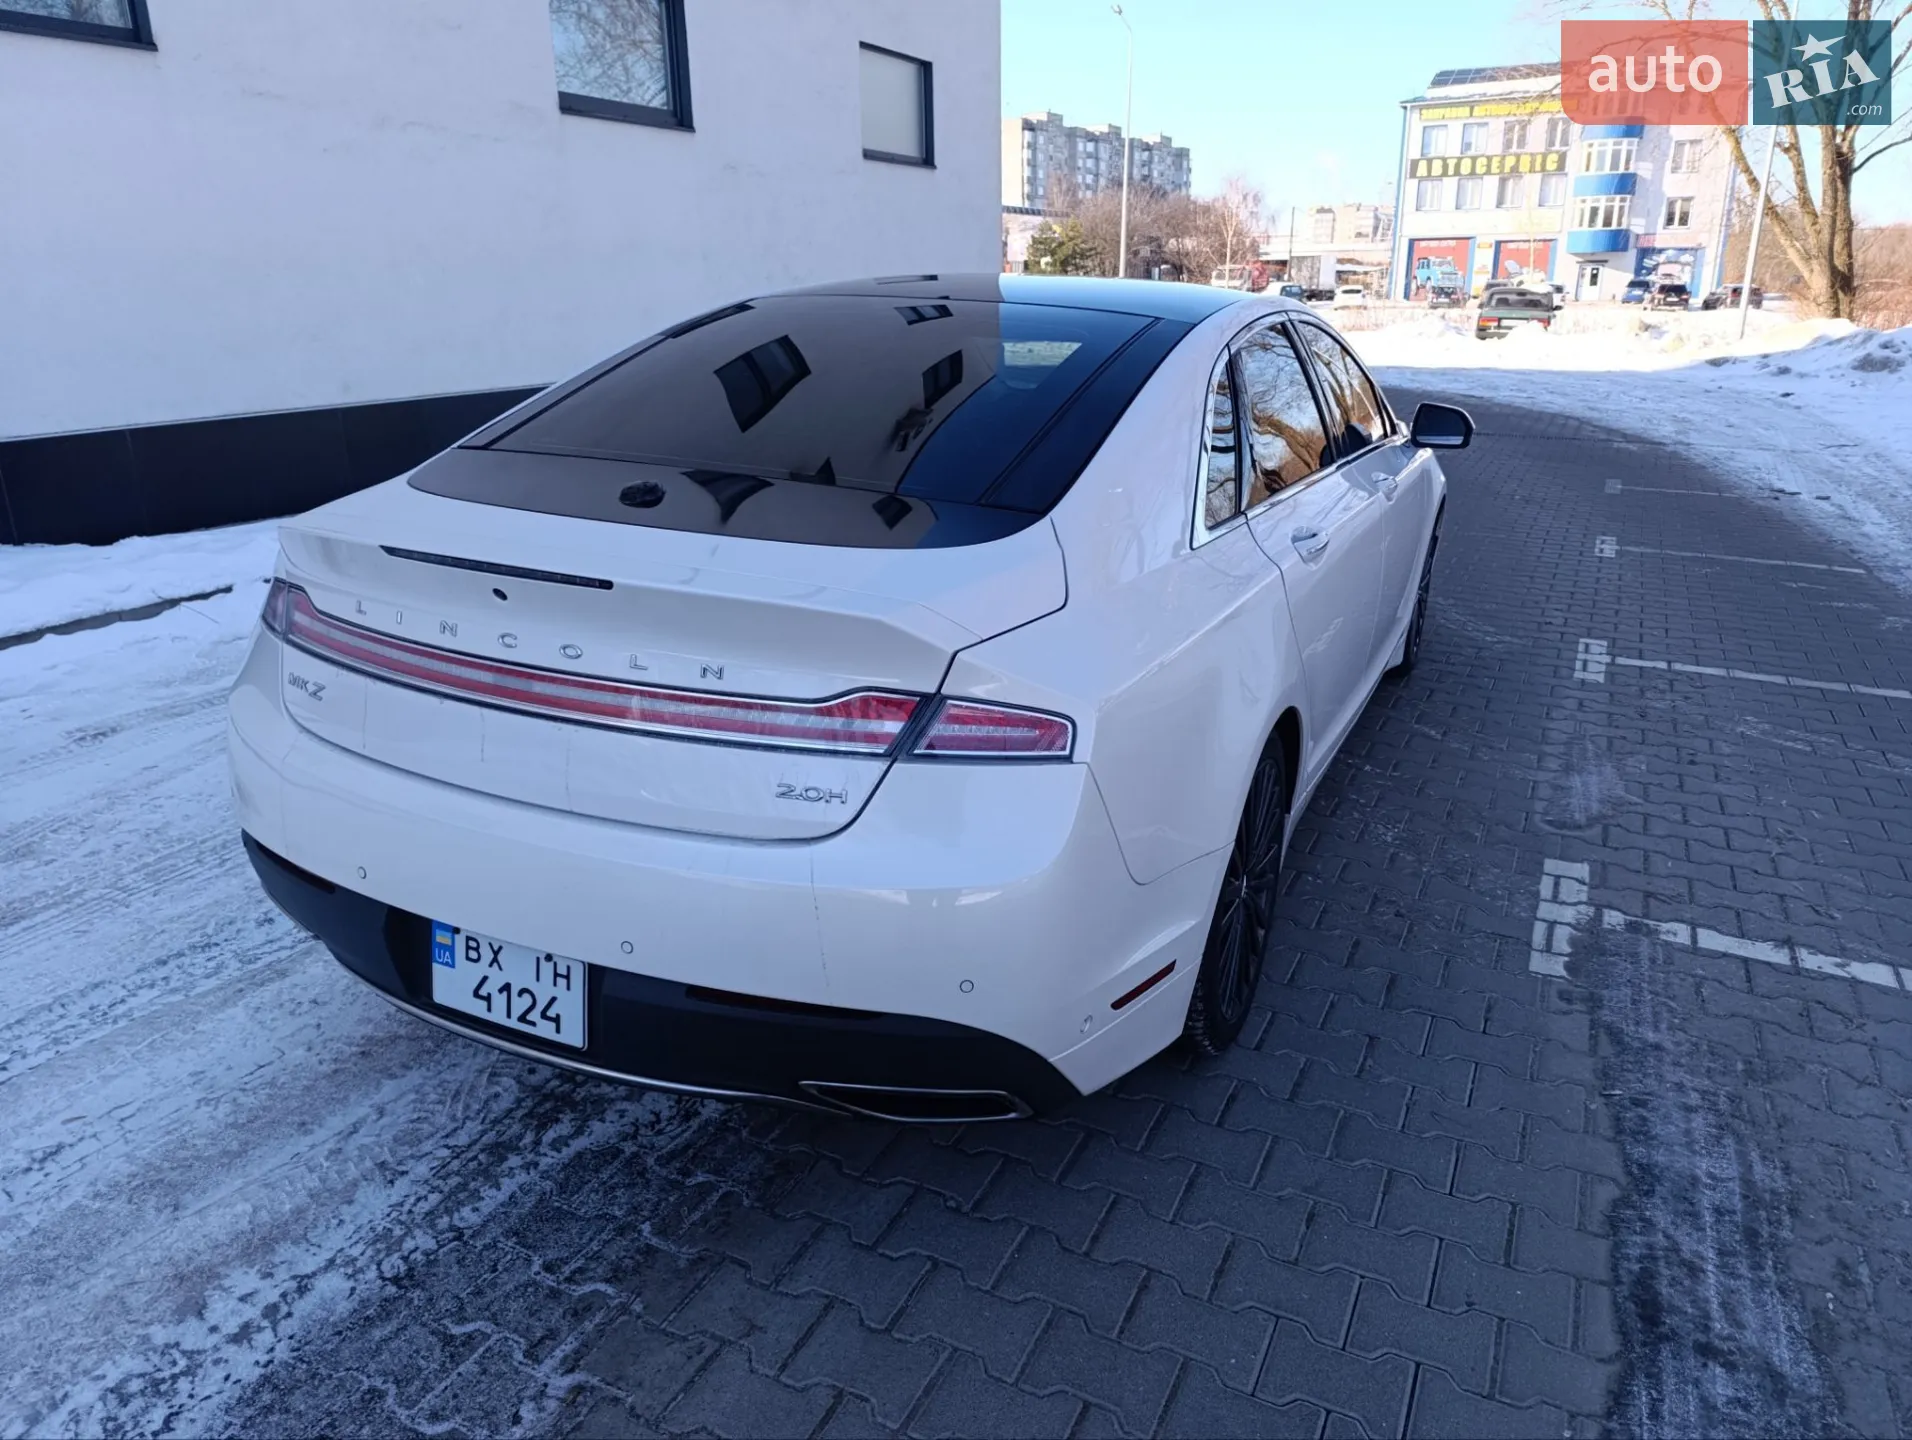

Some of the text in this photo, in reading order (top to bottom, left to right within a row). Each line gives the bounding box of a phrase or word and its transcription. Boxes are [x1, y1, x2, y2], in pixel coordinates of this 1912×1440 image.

[355, 600, 725, 681] LINCOLN
[287, 671, 326, 702] MKZ
[435, 948, 453, 966] UA
[465, 935, 504, 972] BX
[472, 975, 562, 1035] 4124
